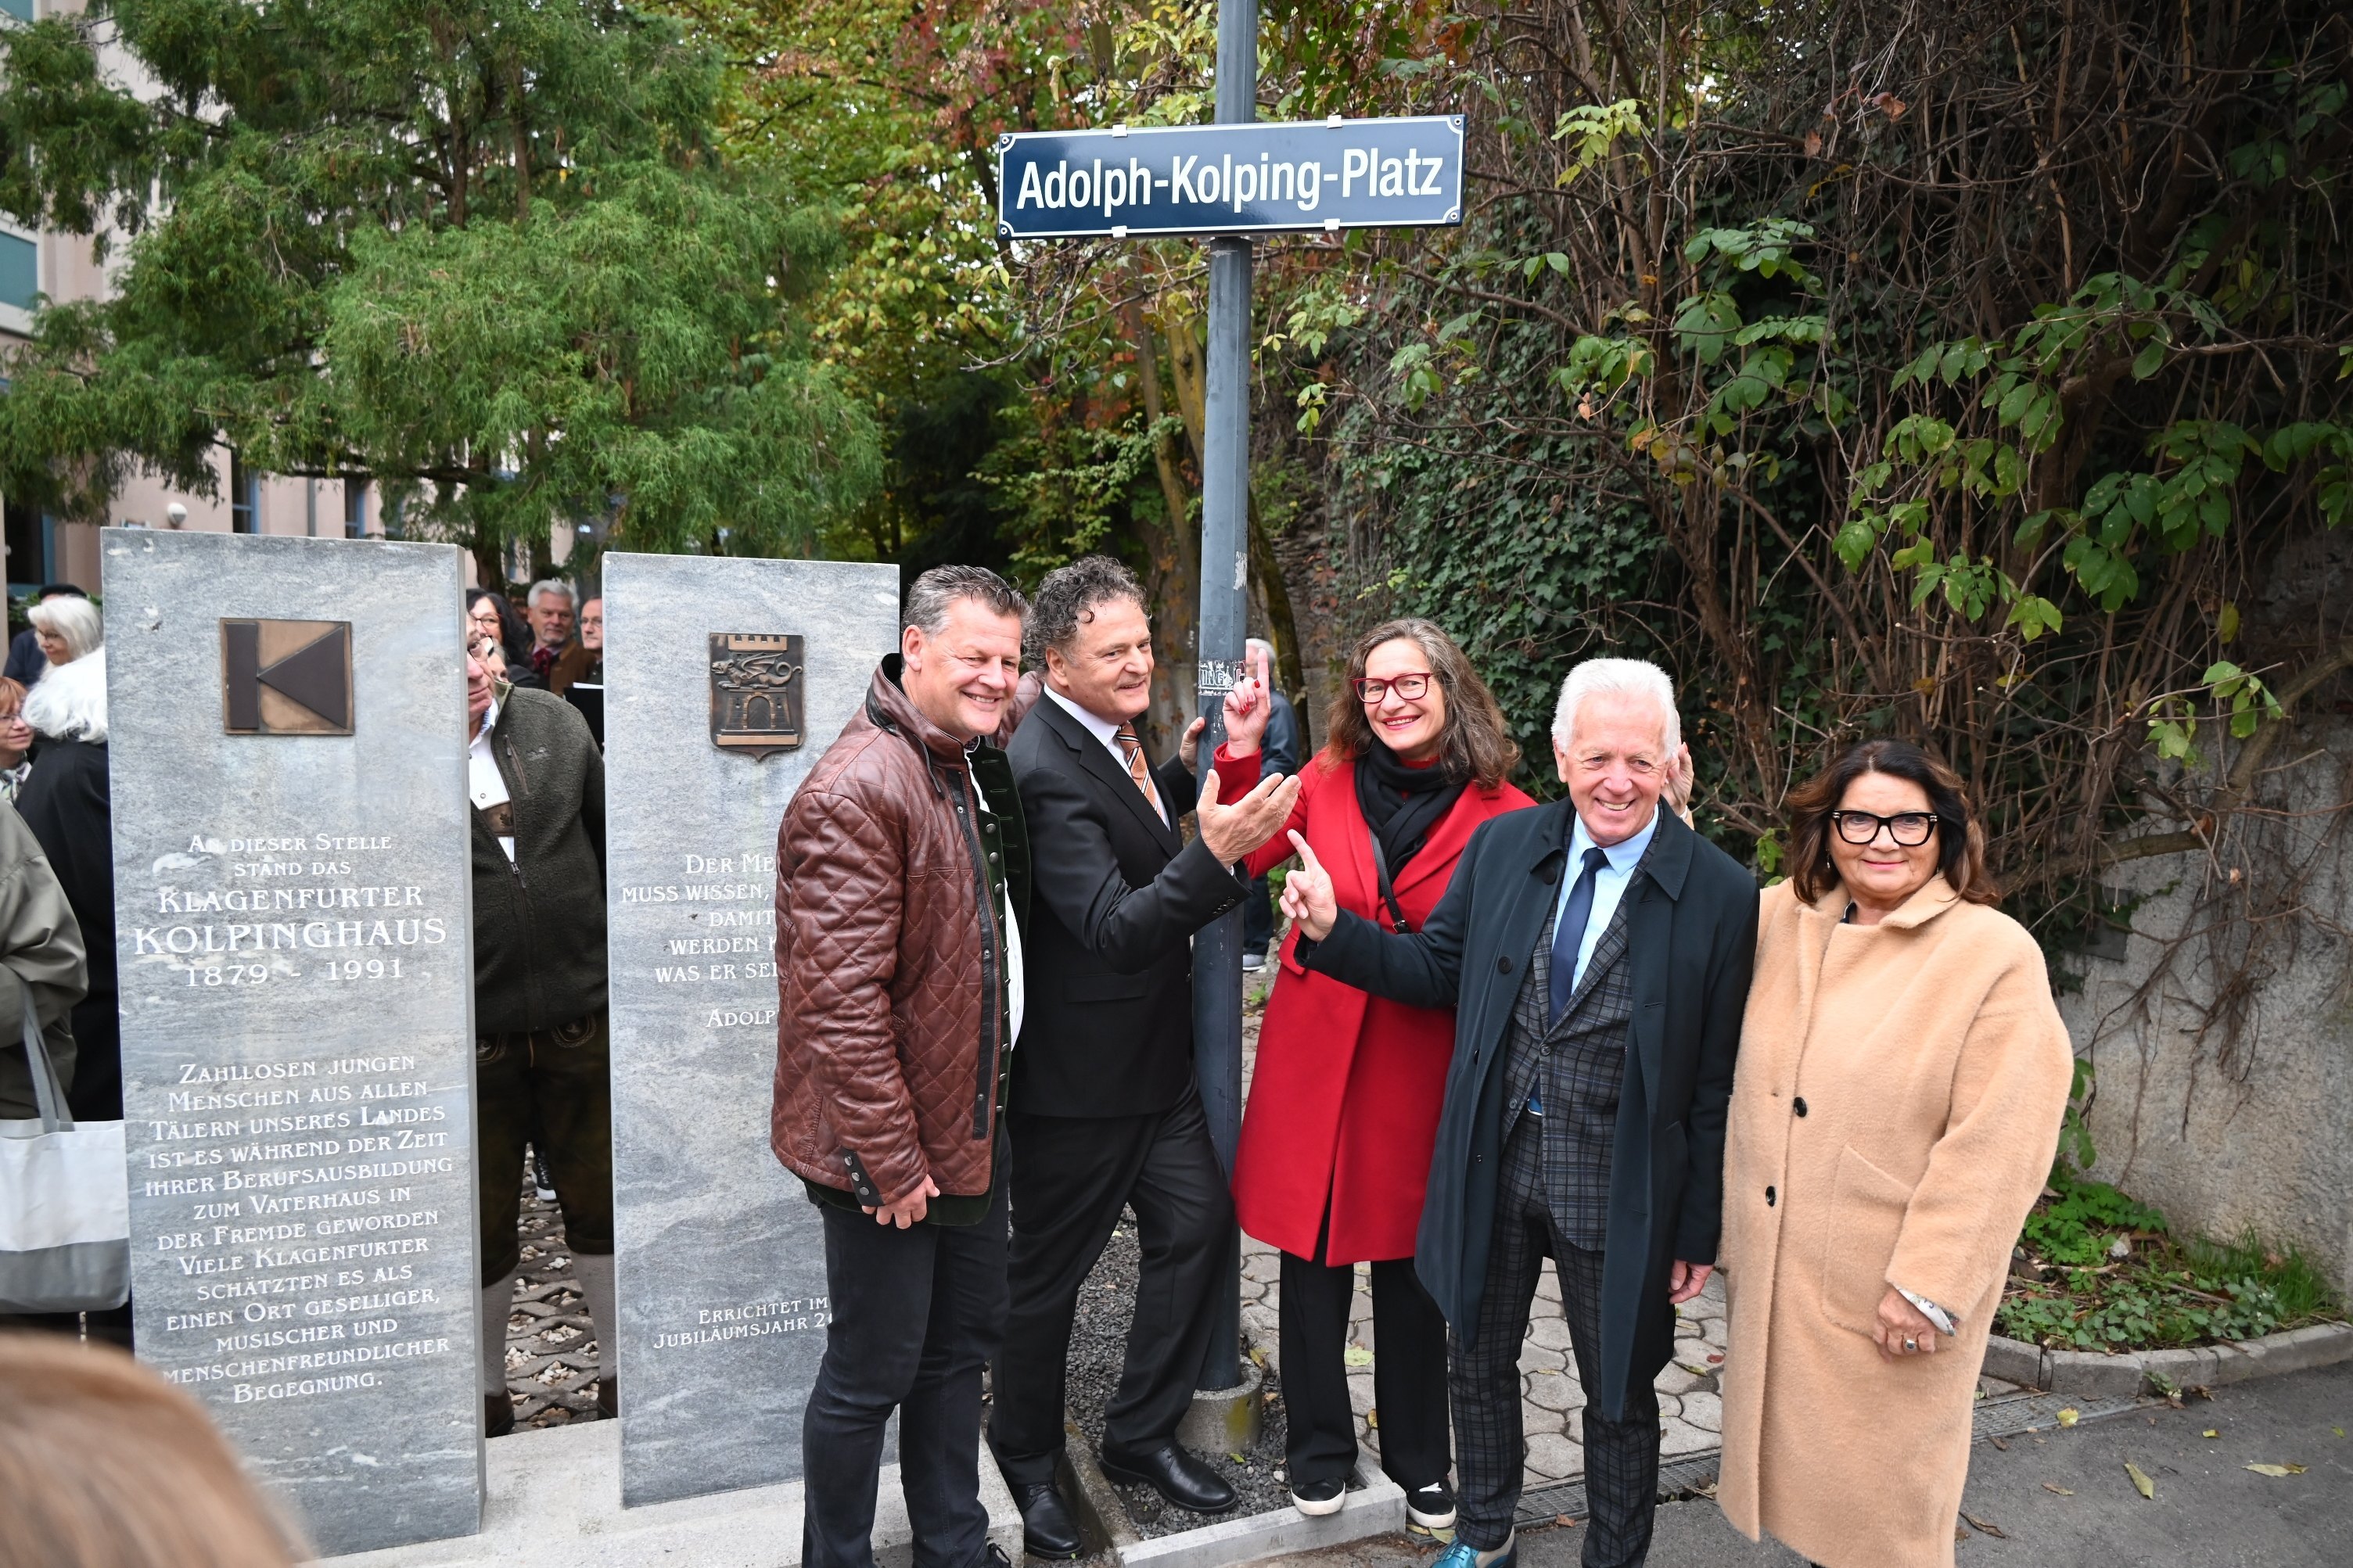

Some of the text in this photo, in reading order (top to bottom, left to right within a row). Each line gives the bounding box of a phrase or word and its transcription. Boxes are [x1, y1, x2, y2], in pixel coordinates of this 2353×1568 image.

[1016, 147, 1444, 218] Adolph-Kolping-Platz
[232, 838, 307, 851] DIESER
[316, 834, 391, 850] STELLE
[235, 862, 350, 876] STAND DAS
[685, 855, 733, 874] DER
[159, 887, 422, 913] KLAGENFURTER
[623, 884, 769, 902] MUSS WISSEN,
[709, 909, 776, 926] DAMIT
[135, 919, 445, 956] KOLPINGHAUS
[670, 938, 758, 955] WERDEN
[185, 965, 268, 986] 1879
[327, 959, 403, 980] 1991
[655, 966, 699, 982] WAS
[710, 964, 736, 980] ER
[706, 1009, 780, 1027] ADOLP
[180, 1057, 414, 1083] ZAHLLOSEN JUNGEN
[169, 1082, 426, 1111] MENSCHEN AUS ALLEN
[149, 1107, 444, 1140] TÄLERN UNSERES LANDES
[149, 1130, 447, 1169] IST ES WÄHREND DER ZEIT
[146, 1158, 451, 1196] IHRER BERUFSAUSBILDUNG
[194, 1187, 410, 1219] ZUM VATERHAUS IN
[158, 1210, 439, 1250] DER FREMDE GEWORDEN
[178, 1238, 429, 1275] VIELE KLAGENFURTER
[197, 1265, 411, 1301] SCHÄTZTEN ES ALS
[167, 1289, 439, 1331] EINEN ORT GESELLIGER,
[699, 1297, 828, 1324] ERRICHTET IM
[217, 1319, 397, 1351] MUSISCHER UND
[654, 1317, 807, 1348] JUBILÄUMSJAHR
[234, 1372, 382, 1403] BEGEGNUNG.
